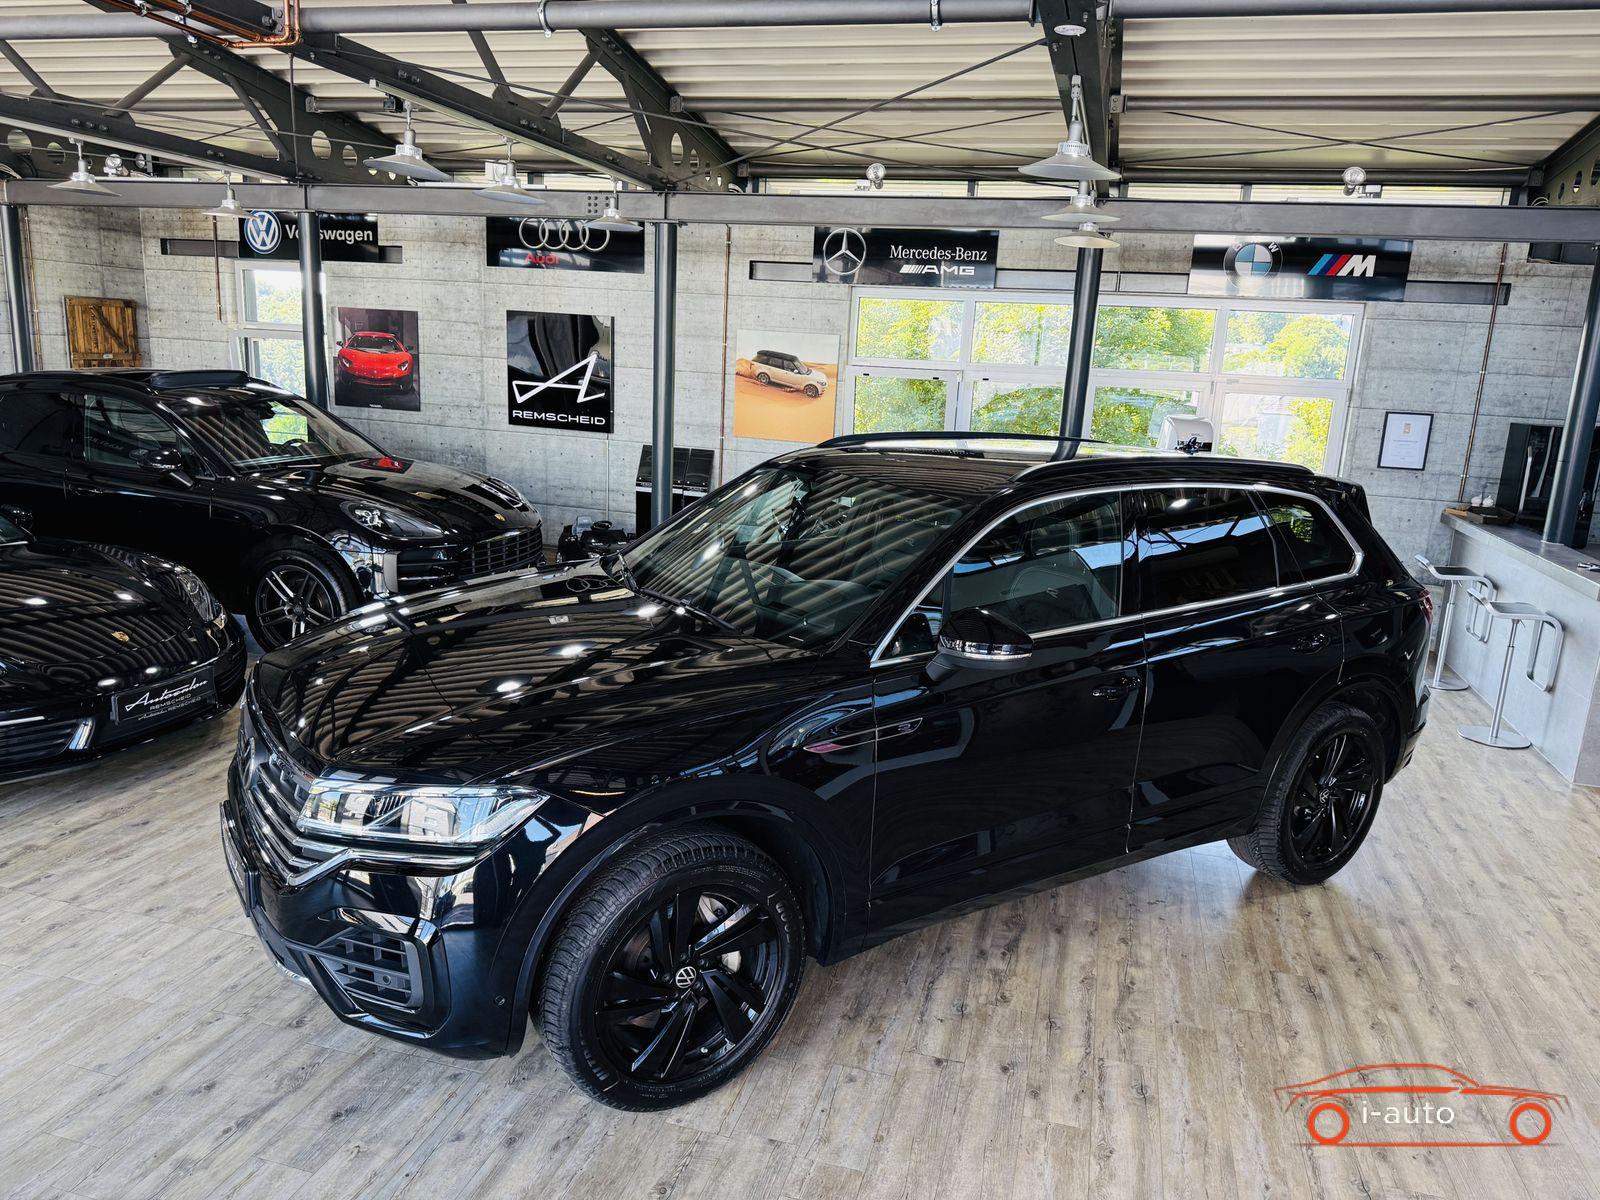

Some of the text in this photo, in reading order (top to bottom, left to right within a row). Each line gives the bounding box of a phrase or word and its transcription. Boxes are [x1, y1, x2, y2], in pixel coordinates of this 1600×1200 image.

[285, 224, 373, 245] Vswagen
[889, 244, 988, 262] Mercedes-Benz
[920, 264, 976, 276] AMG
[512, 409, 606, 426] REMSCHEID
[149, 693, 192, 711] REMSCHEID
